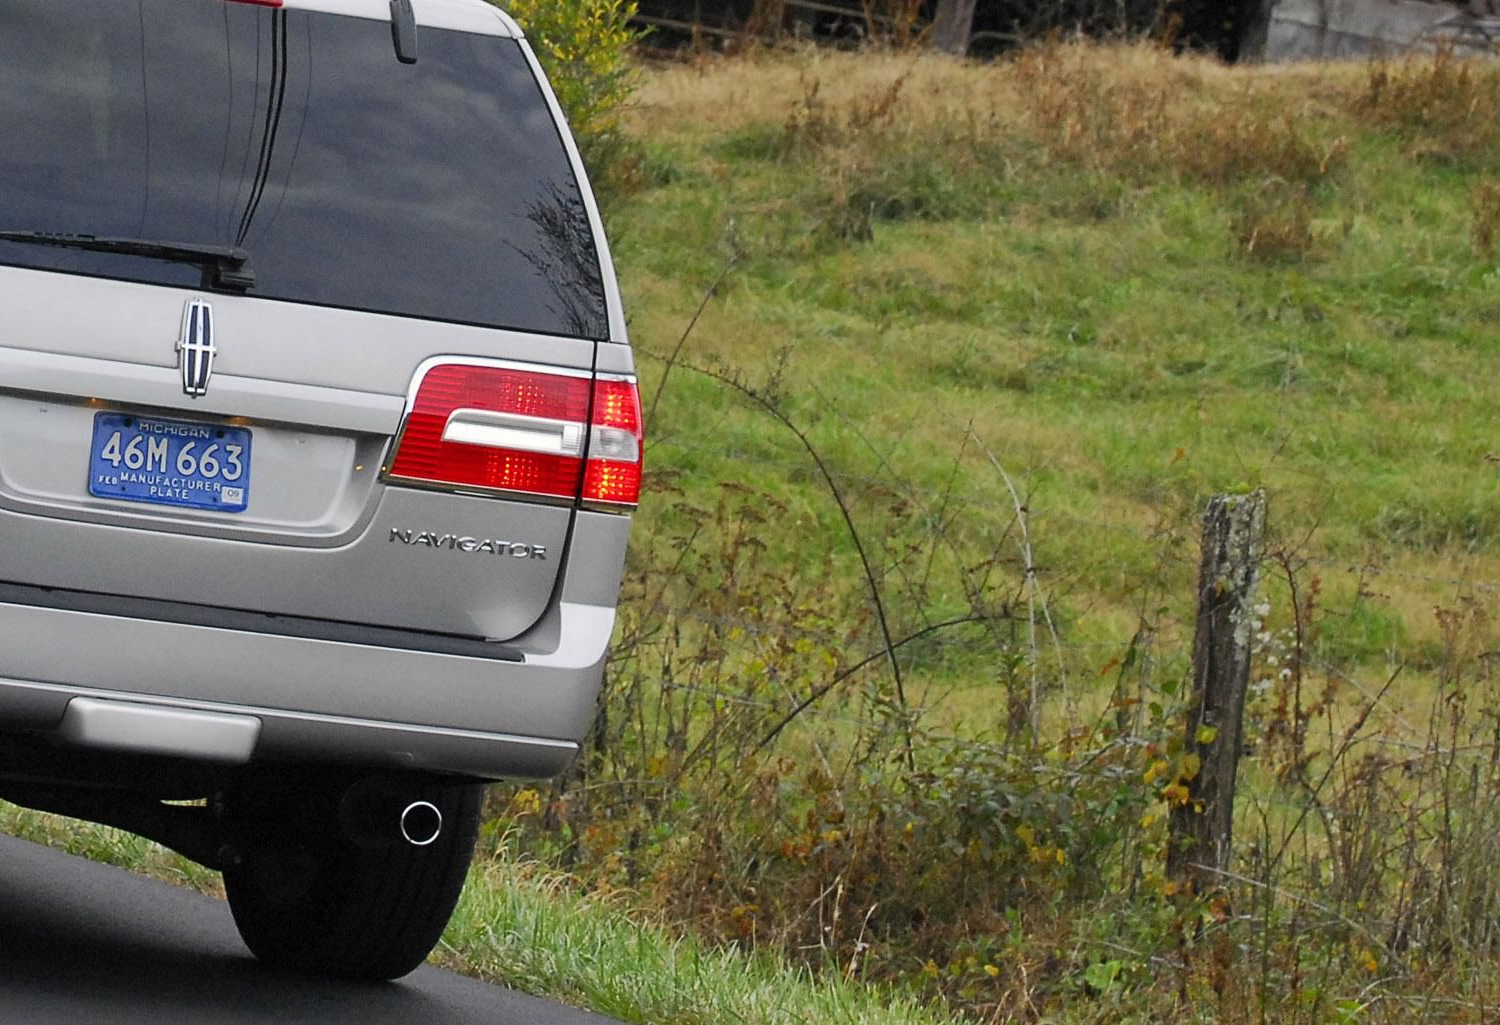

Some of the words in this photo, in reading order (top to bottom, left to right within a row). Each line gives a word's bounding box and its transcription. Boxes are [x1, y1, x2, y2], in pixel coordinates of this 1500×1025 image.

[138, 422, 210, 440] MICHIGAN
[101, 431, 169, 474] 46M
[176, 441, 243, 482] 663
[99, 475, 118, 485] FEB
[120, 471, 221, 492] MANUFACTURER
[150, 487, 189, 499] PLATE
[388, 527, 548, 561] NAVIGATOR
